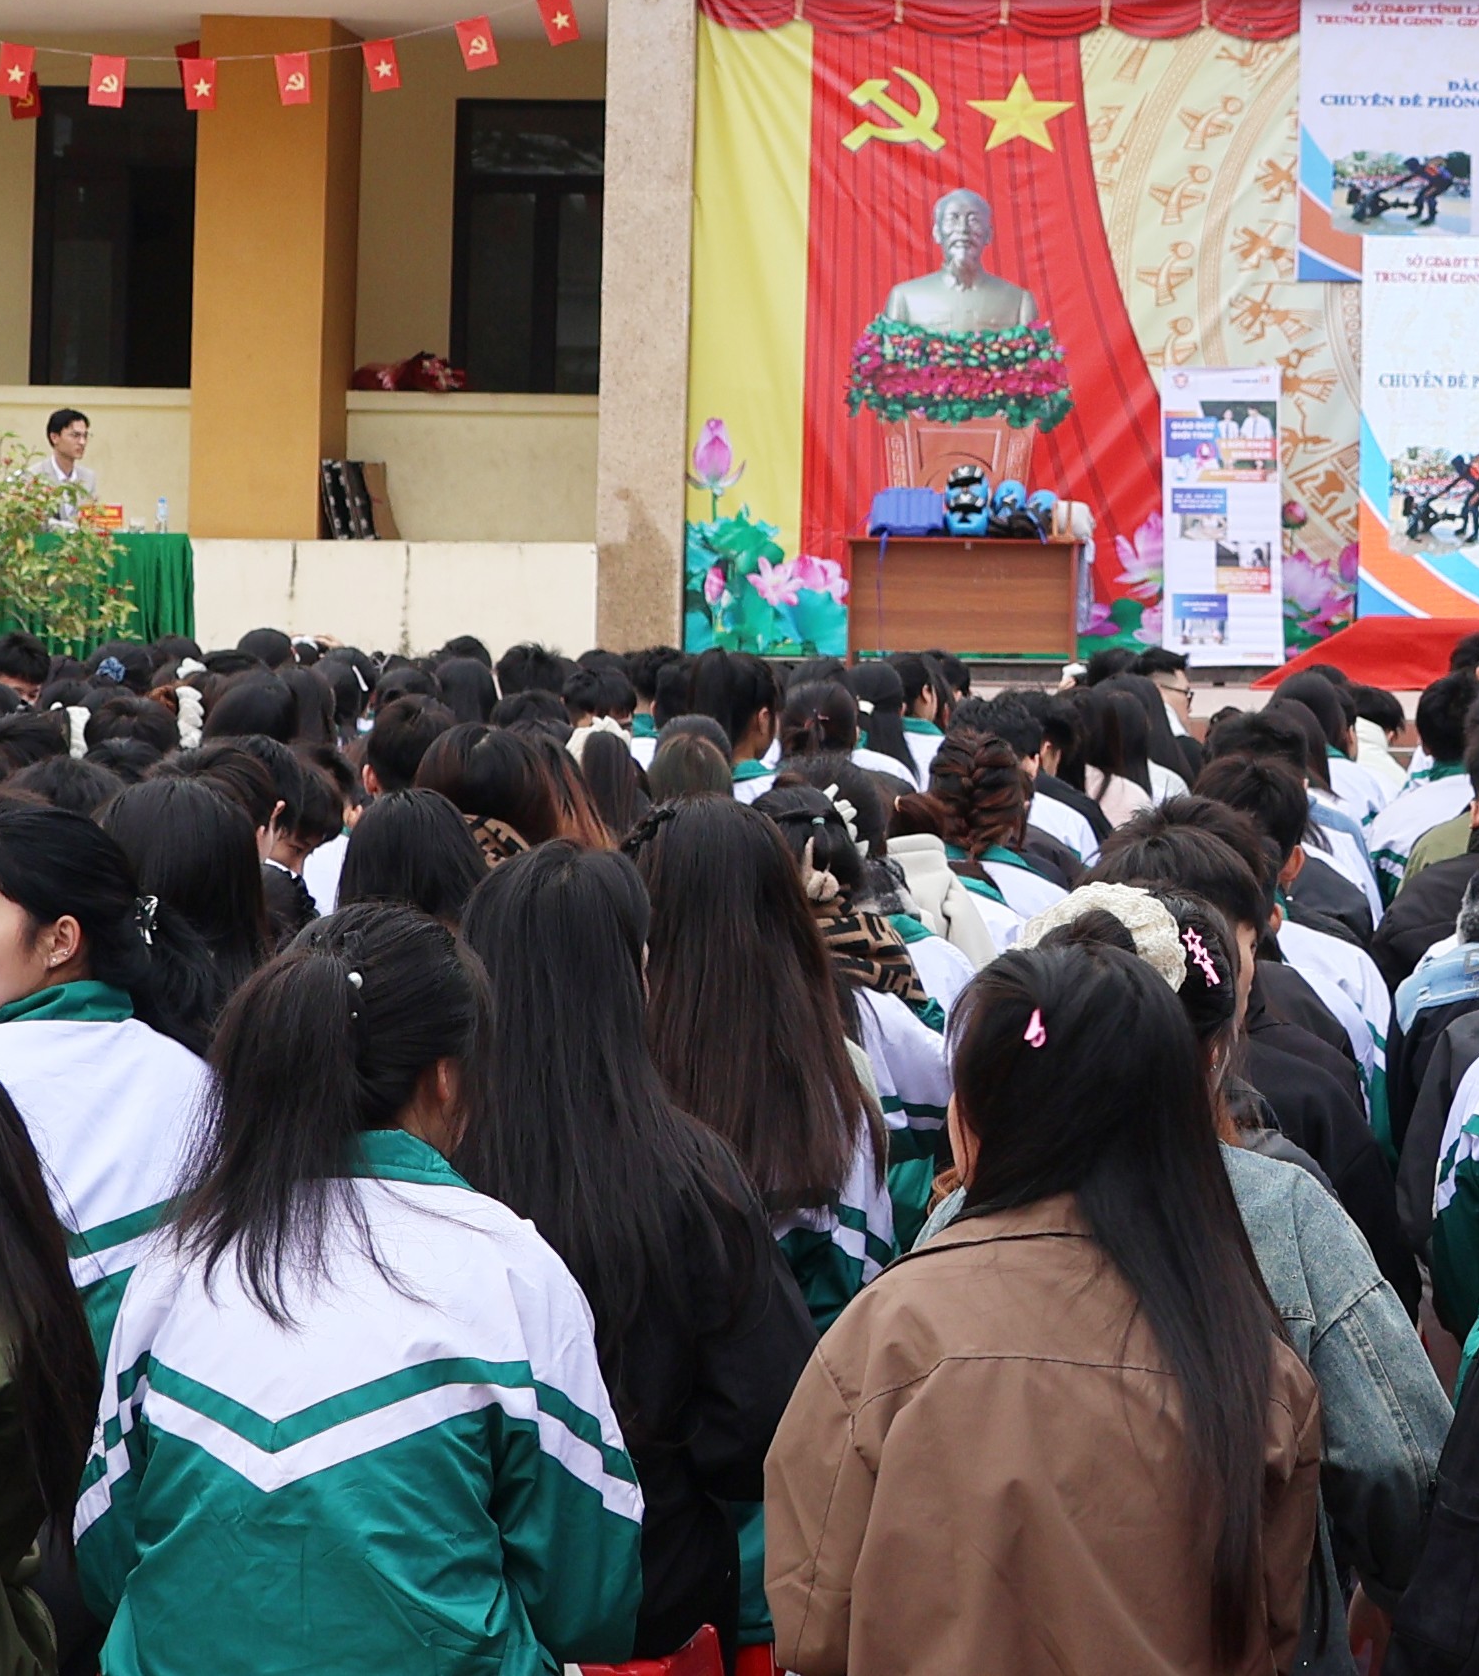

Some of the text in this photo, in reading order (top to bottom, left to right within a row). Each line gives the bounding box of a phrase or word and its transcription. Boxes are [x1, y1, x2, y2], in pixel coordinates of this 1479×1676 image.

[1316, 15, 1364, 25] TRUNG
[1369, 14, 1399, 26] TÂM
[1320, 90, 1395, 107] CHUYÊN
[1399, 90, 1422, 107] ĐỀ
[1375, 271, 1420, 283] TRUNG
[1421, 269, 1448, 284] TÂM
[1378, 369, 1444, 388] CHUYÊN
[1447, 369, 1467, 388] ĐỀ
